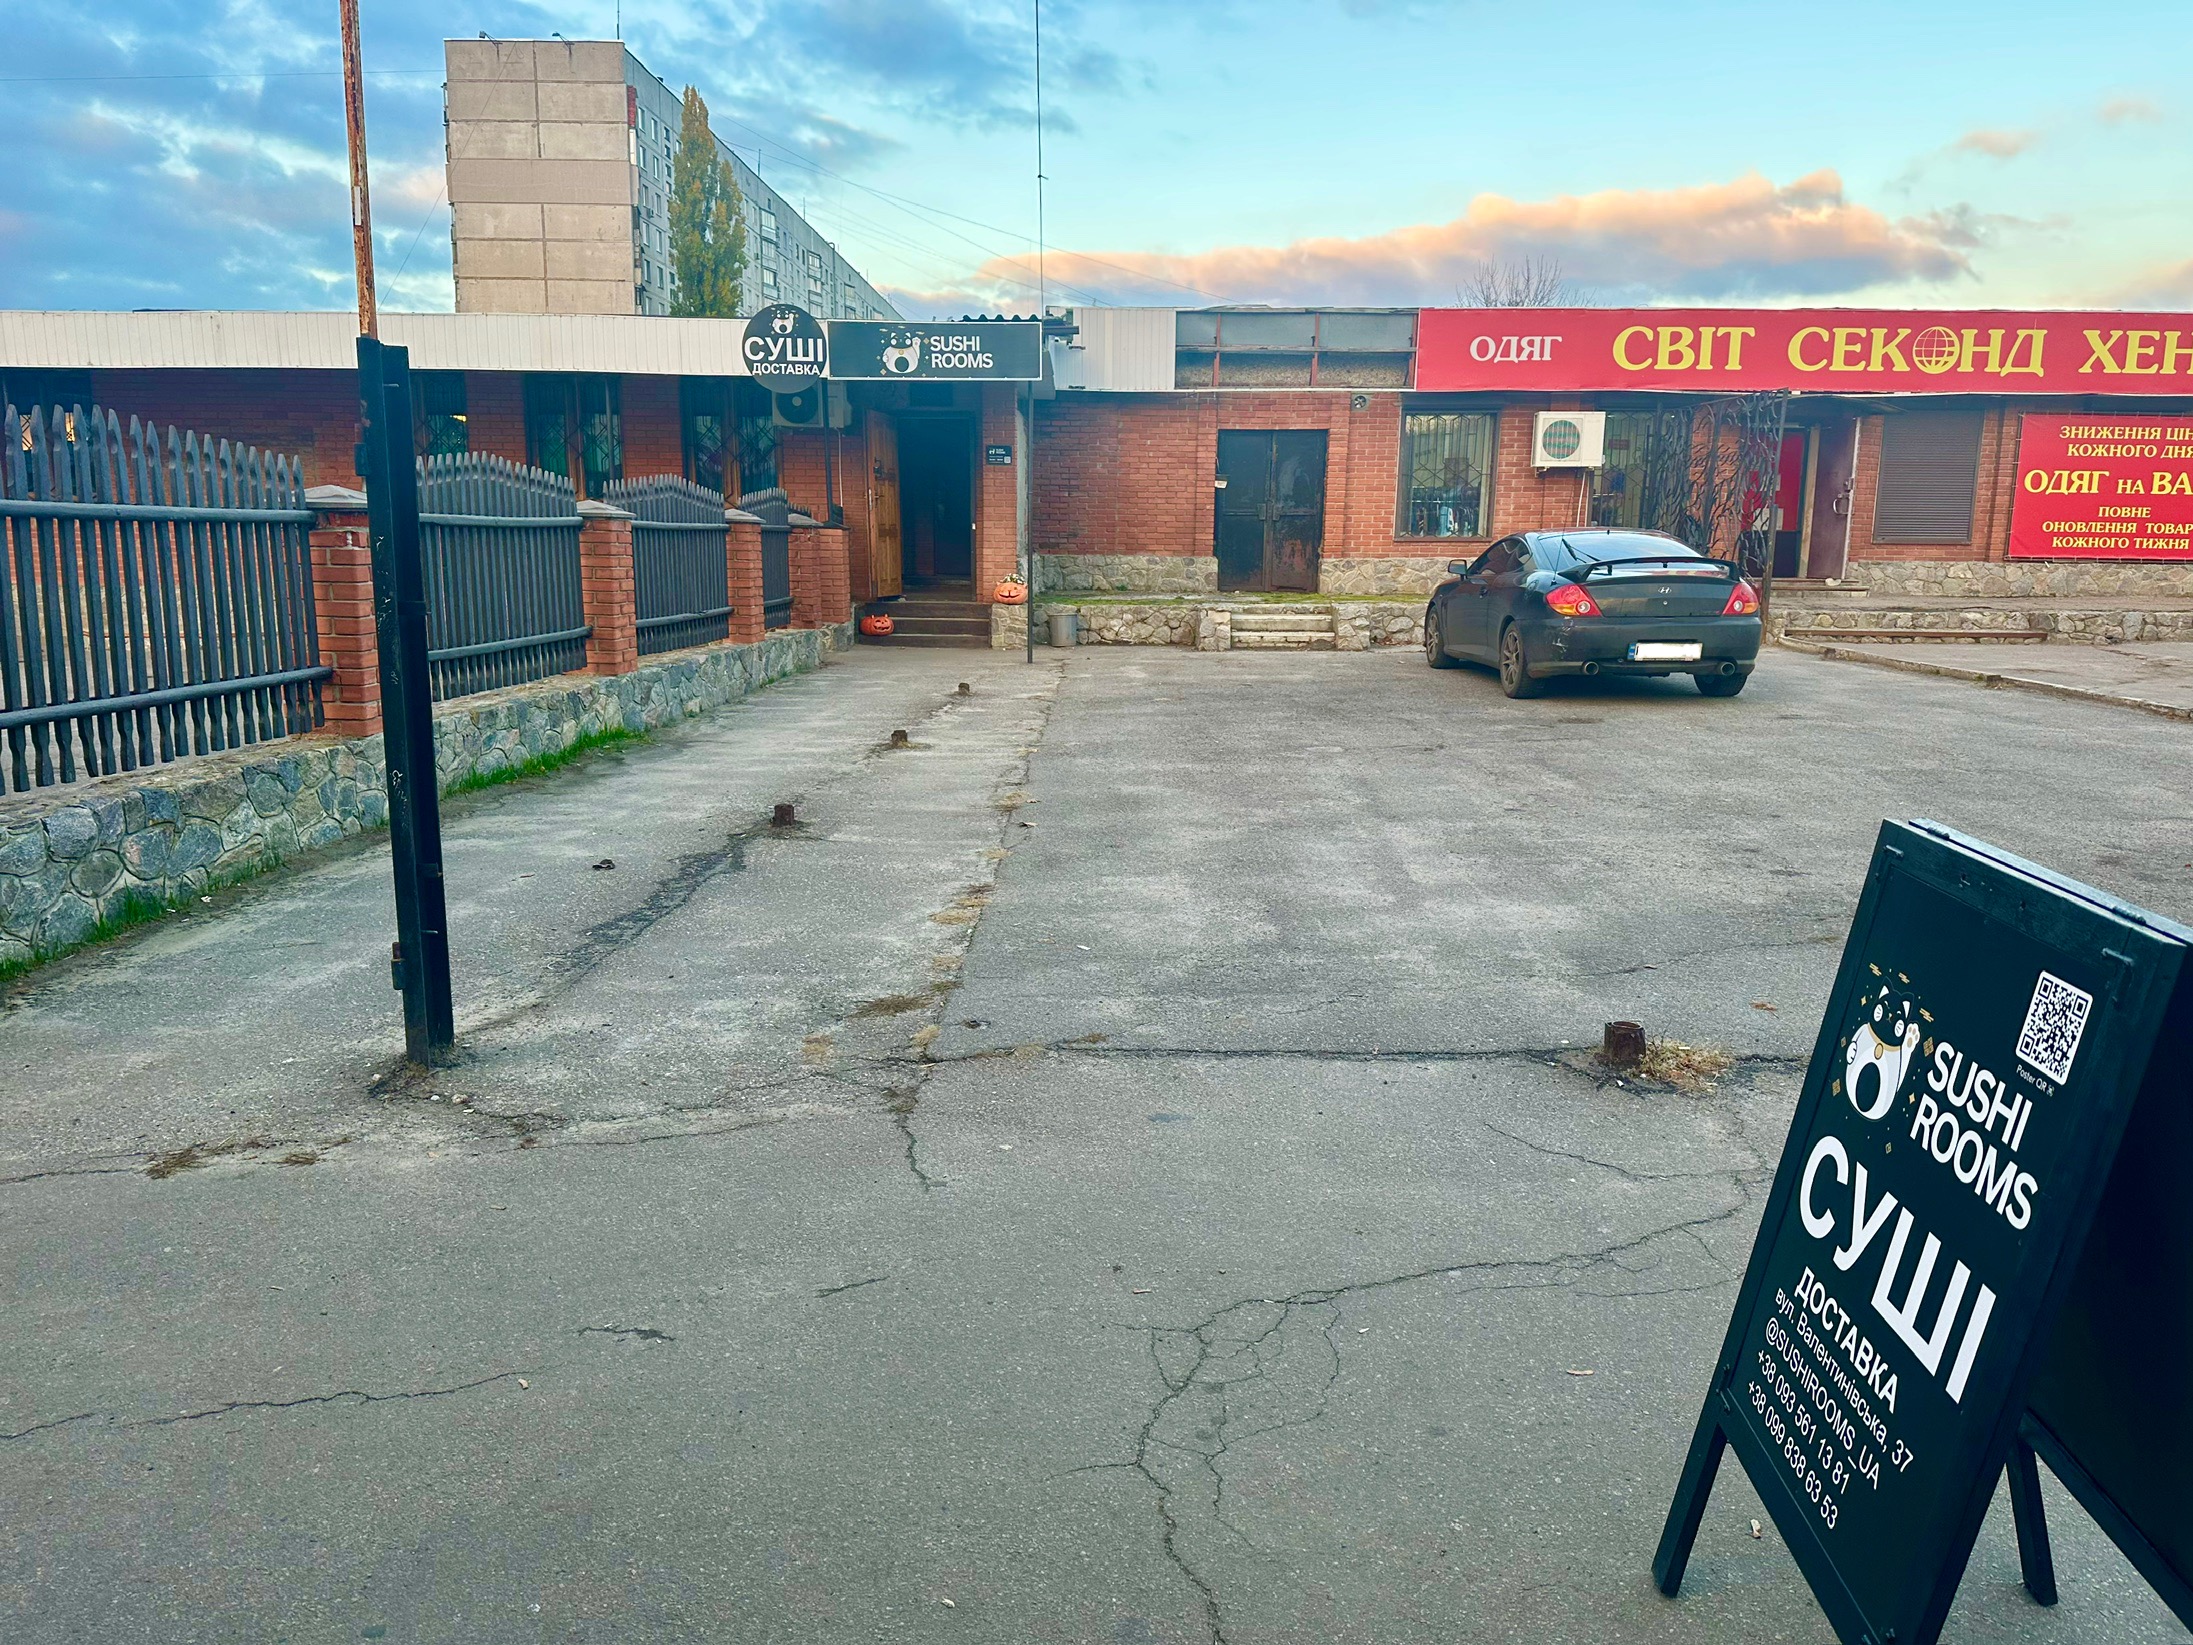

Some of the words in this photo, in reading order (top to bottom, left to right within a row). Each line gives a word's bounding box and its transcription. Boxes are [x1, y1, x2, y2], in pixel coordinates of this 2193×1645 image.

[744, 336, 824, 362] СУШІ
[929, 335, 981, 352] SUSHI
[1469, 336, 1563, 364] ОДЯГ
[1612, 325, 1756, 371] СВІТ
[1787, 326, 2048, 378] СЕКОНД
[751, 363, 821, 376] ДОСТАВКА
[930, 352, 994, 369] ROOMS
[2059, 425, 2163, 440] ЗНИЖЕННЯ
[2067, 444, 2158, 458] КОЖНОГО
[2024, 469, 2110, 496] ОДЯГ
[2116, 479, 2145, 495] НА
[2150, 471, 2193, 496] ВА
[2098, 506, 2152, 518] ПОВНЕ
[2042, 521, 2138, 534] ОНОВЛЕННЯ
[2145, 522, 2193, 535] ТОВАР
[2052, 537, 2130, 549] КОЖНОГО
[2133, 537, 2190, 550] ТИЖНЯ
[2016, 1064, 2036, 1084] Poster
[1927, 1041, 2033, 1153] SUSHI
[1909, 1092, 2039, 1230] ROOMS
[1799, 1135, 1997, 1405] СУШІ
[1793, 1266, 1898, 1414] ДОСТАВКА
[1775, 1288, 1795, 1324] вул.
[1796, 1311, 1887, 1453] Валентинівська,
[1891, 1439, 1914, 1473] 37
[1765, 1317, 1880, 1490] @SUSHIROOMS_UA
[1758, 1349, 1777, 1384] +38
[1775, 1374, 1796, 1413] 093
[1794, 1403, 1817, 1445] 561
[1817, 1438, 1834, 1470] 13
[1832, 1460, 1850, 1495] 81
[1748, 1380, 1767, 1415] +38
[1765, 1405, 1786, 1445] 099
[1783, 1436, 1807, 1479] 838
[1805, 1470, 1822, 1503] 63
[1820, 1494, 1838, 1530] 53
